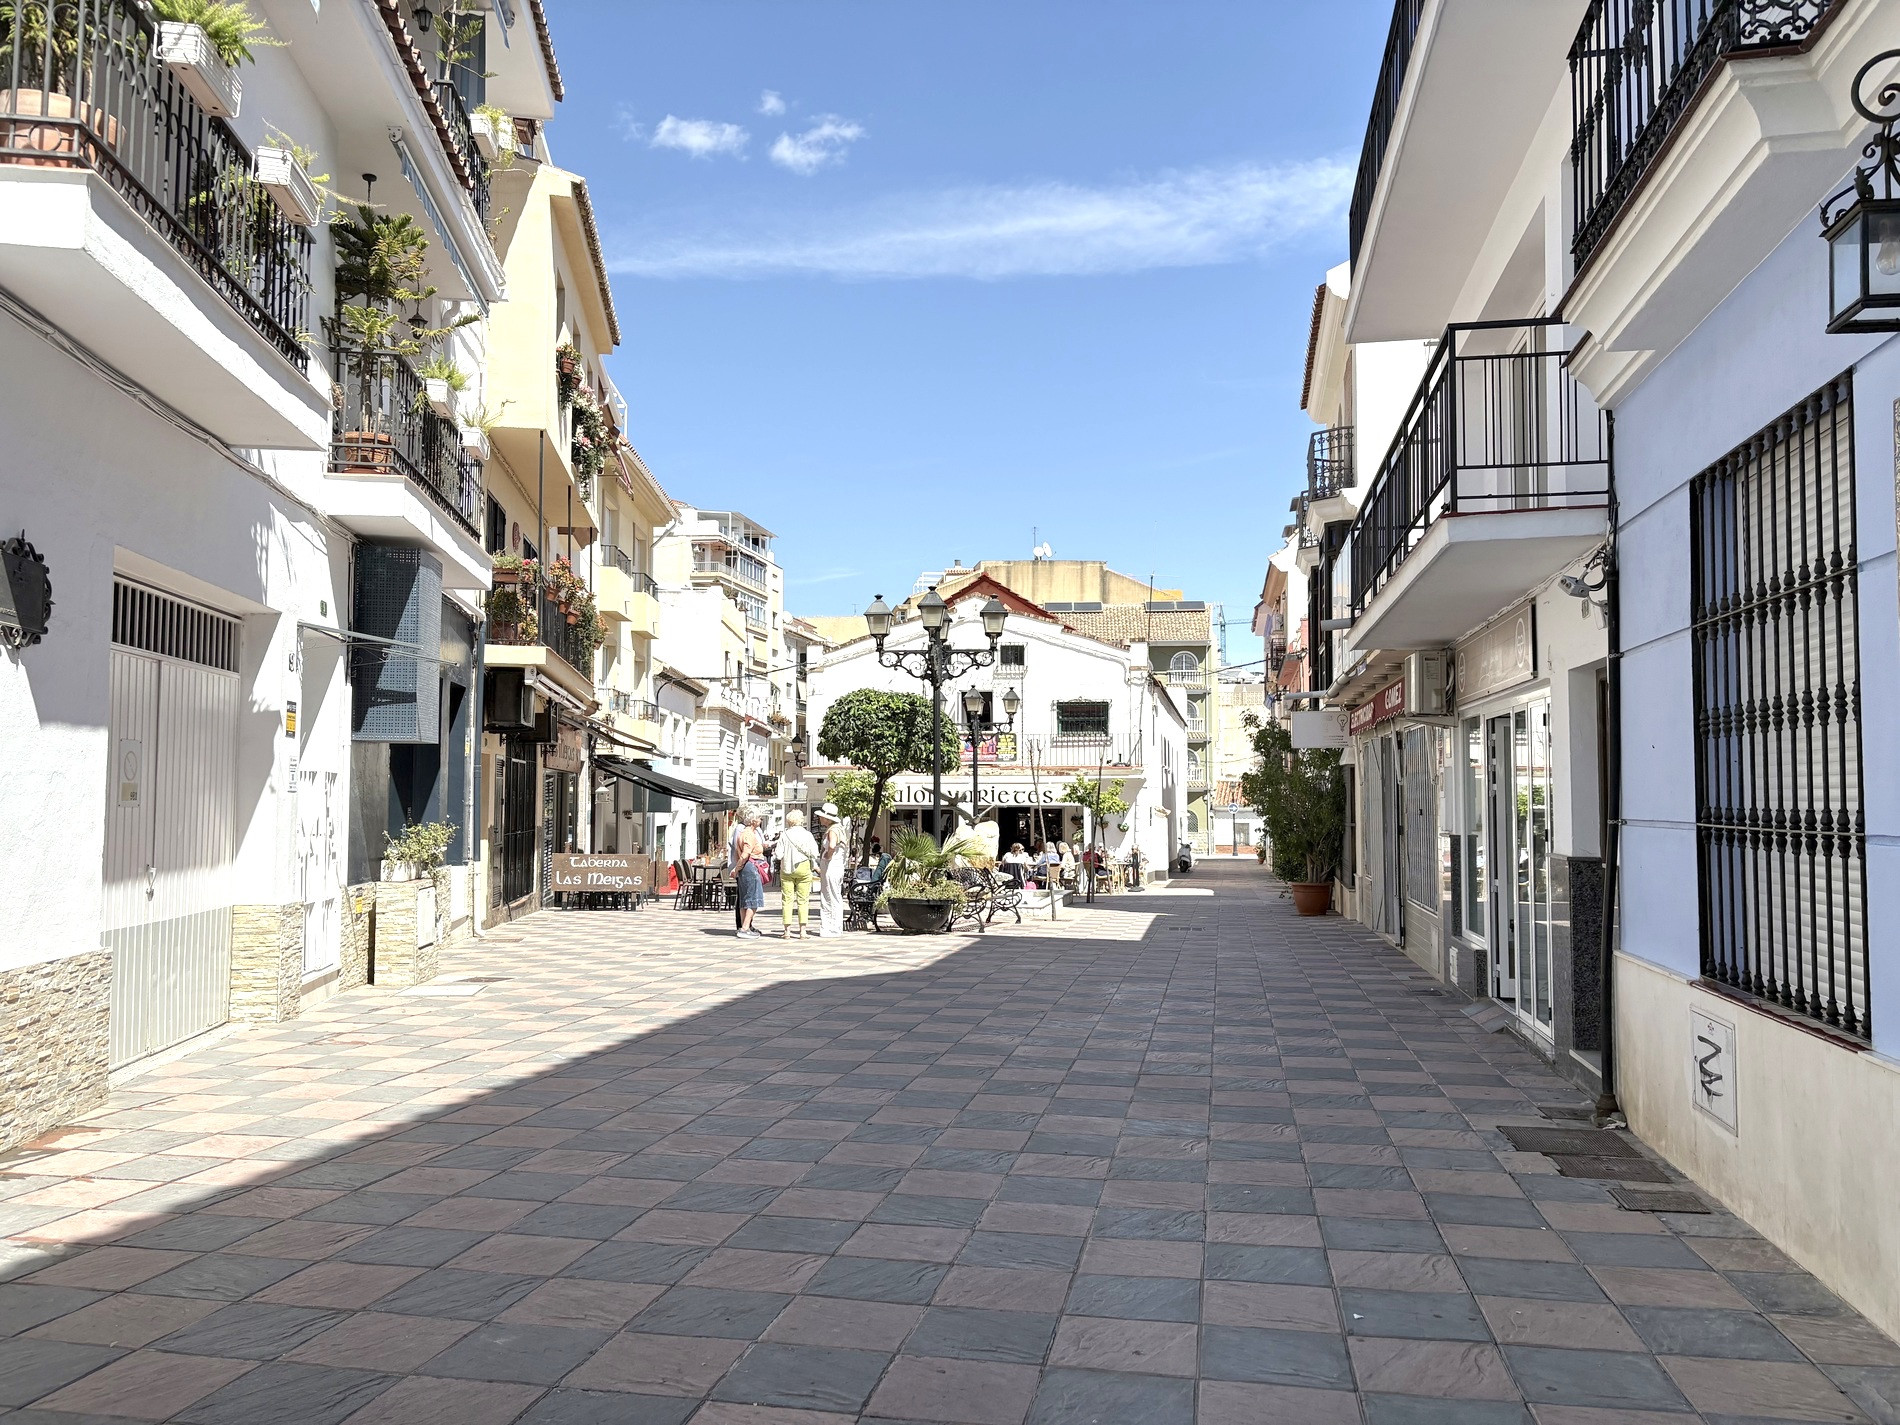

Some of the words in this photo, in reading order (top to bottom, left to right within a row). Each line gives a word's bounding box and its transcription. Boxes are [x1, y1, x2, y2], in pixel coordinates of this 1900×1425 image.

[569, 856, 628, 868] Taberna
[555, 870, 582, 885] Las
[587, 872, 642, 889] Meigas
